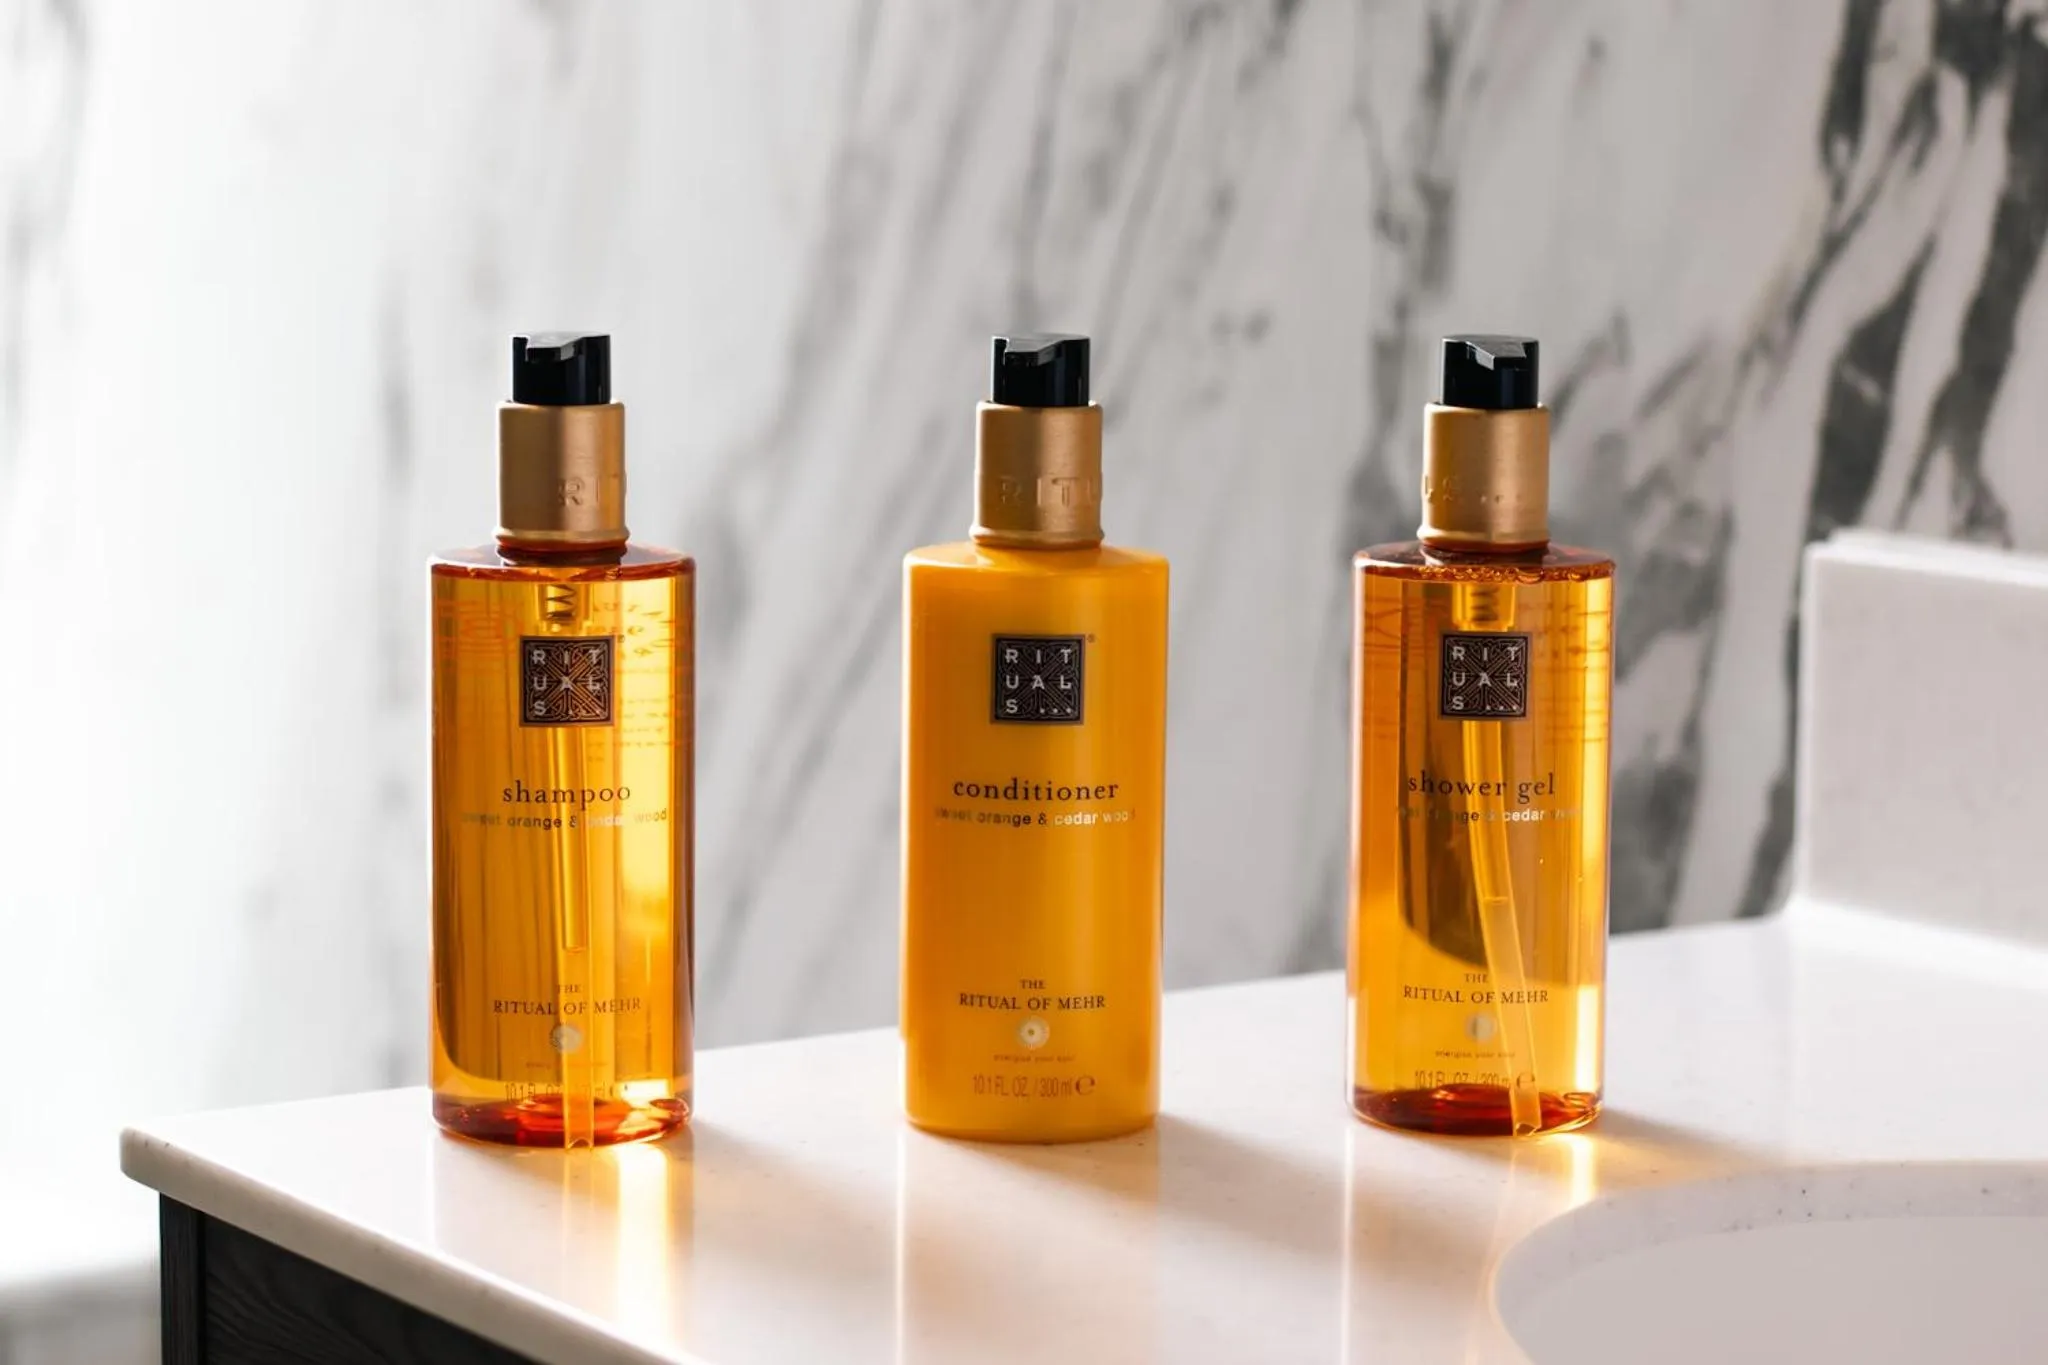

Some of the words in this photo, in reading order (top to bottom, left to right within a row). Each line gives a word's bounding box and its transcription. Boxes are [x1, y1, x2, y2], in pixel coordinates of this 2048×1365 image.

[502, 779, 631, 811] shampoo
[953, 777, 1119, 801] conditioner
[1408, 770, 1508, 796] shower
[1518, 772, 1555, 805] gel
[507, 813, 562, 831] orange
[569, 815, 578, 828] &
[977, 811, 1032, 828] orange
[1038, 812, 1048, 826] &
[1054, 810, 1099, 826] cedar
[1503, 808, 1545, 823] cedar
[1020, 979, 1046, 990] THE
[1464, 973, 1489, 984] THE
[558, 984, 582, 995] THE
[1403, 985, 1465, 1004] RITUAL
[1471, 990, 1497, 1005] OF
[1501, 989, 1549, 1004] MEHR
[493, 999, 558, 1016] RITUAL
[563, 1001, 589, 1016] OF
[593, 997, 642, 1014] MEHR
[958, 992, 1022, 1011] RITUAL
[1027, 996, 1052, 1011] OF
[1057, 995, 1106, 1010] MEHR
